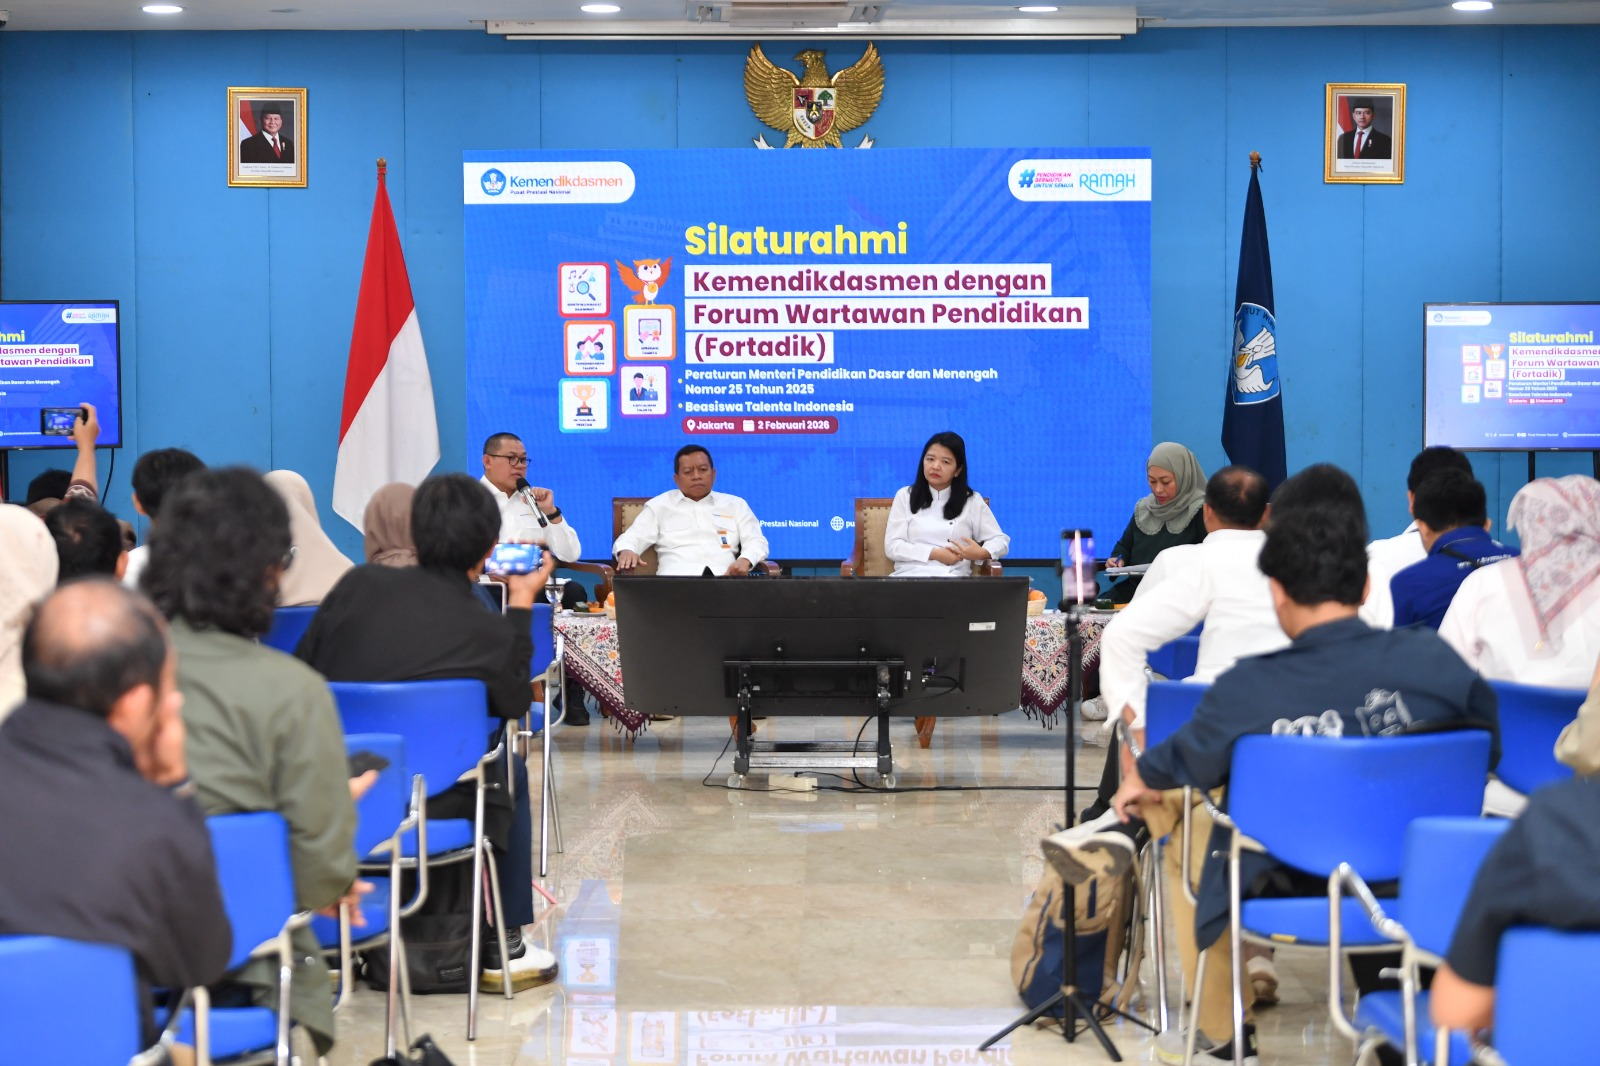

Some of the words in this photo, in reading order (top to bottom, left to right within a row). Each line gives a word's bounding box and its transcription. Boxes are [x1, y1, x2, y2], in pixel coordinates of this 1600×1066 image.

[510, 175, 623, 187] Kemendikdasmen
[1080, 173, 1136, 195] RAMAH
[685, 221, 907, 255] Silaturahmi
[694, 269, 938, 291] Kemendikdasmen
[944, 270, 1046, 297] dengan
[694, 304, 779, 324] Forum
[785, 303, 925, 324] Wartawan
[932, 300, 1082, 323] Pendidikan
[1509, 331, 1593, 343] Silaturahmi
[39, 346, 77, 355] dengan
[695, 333, 826, 362] (Fortadik)
[34, 357, 91, 365] Pendidikan
[685, 369, 746, 379] Peraturan
[748, 368, 796, 379] Menteri
[797, 368, 866, 379] Pendidikan
[869, 368, 905, 379] Dasar
[906, 368, 931, 379] dan
[933, 368, 998, 382] Menengah
[1512, 370, 1562, 379] (Fortadik)
[685, 384, 727, 394] Nomor
[728, 384, 743, 394] 25
[745, 384, 784, 394] Tahun
[786, 384, 814, 394] 2025
[685, 400, 743, 412] Beasiswa
[745, 401, 791, 412] Talenta
[793, 400, 854, 412] Indonesia
[696, 420, 735, 430] Jakarta
[757, 420, 765, 430] 2
[765, 420, 805, 430] Februari
[806, 420, 830, 430] 2026
